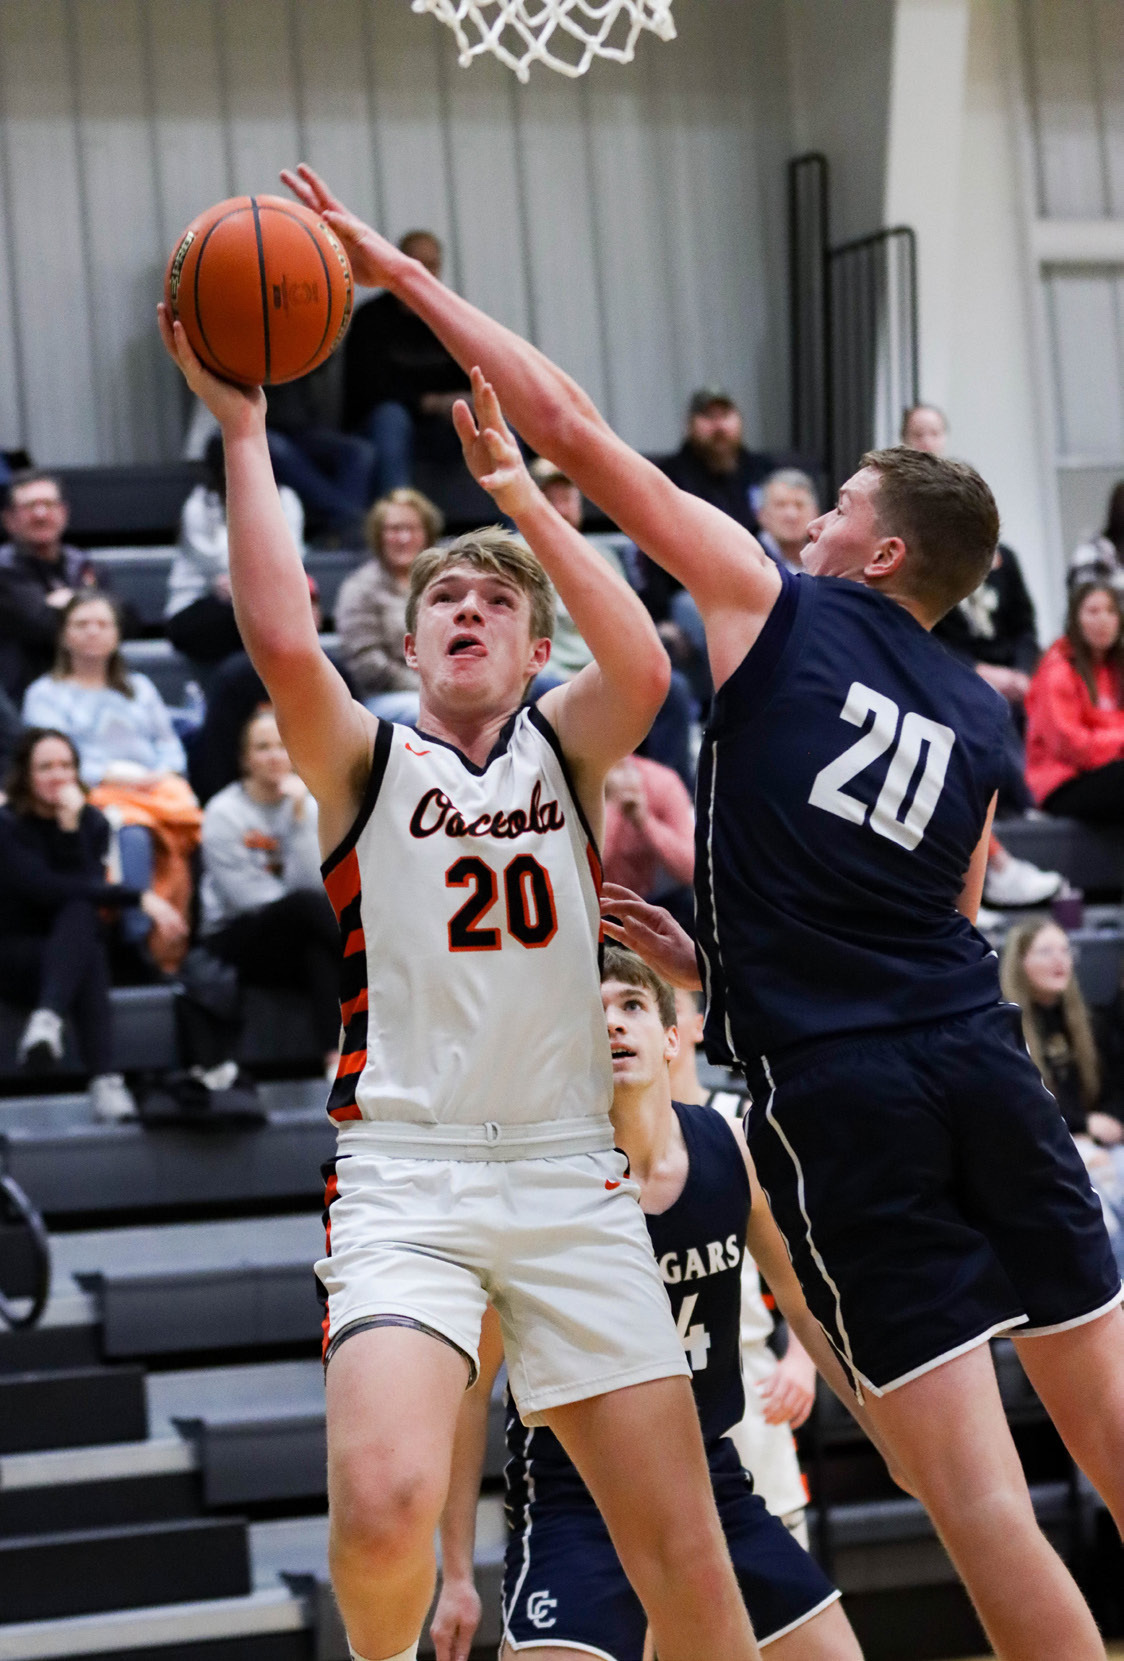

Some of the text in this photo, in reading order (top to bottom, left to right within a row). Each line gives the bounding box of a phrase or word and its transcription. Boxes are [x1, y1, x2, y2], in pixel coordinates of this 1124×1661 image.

[808, 681, 956, 851] 20
[409, 779, 565, 839] Osceola
[445, 853, 558, 952] 20
[654, 1234, 740, 1284] GARS
